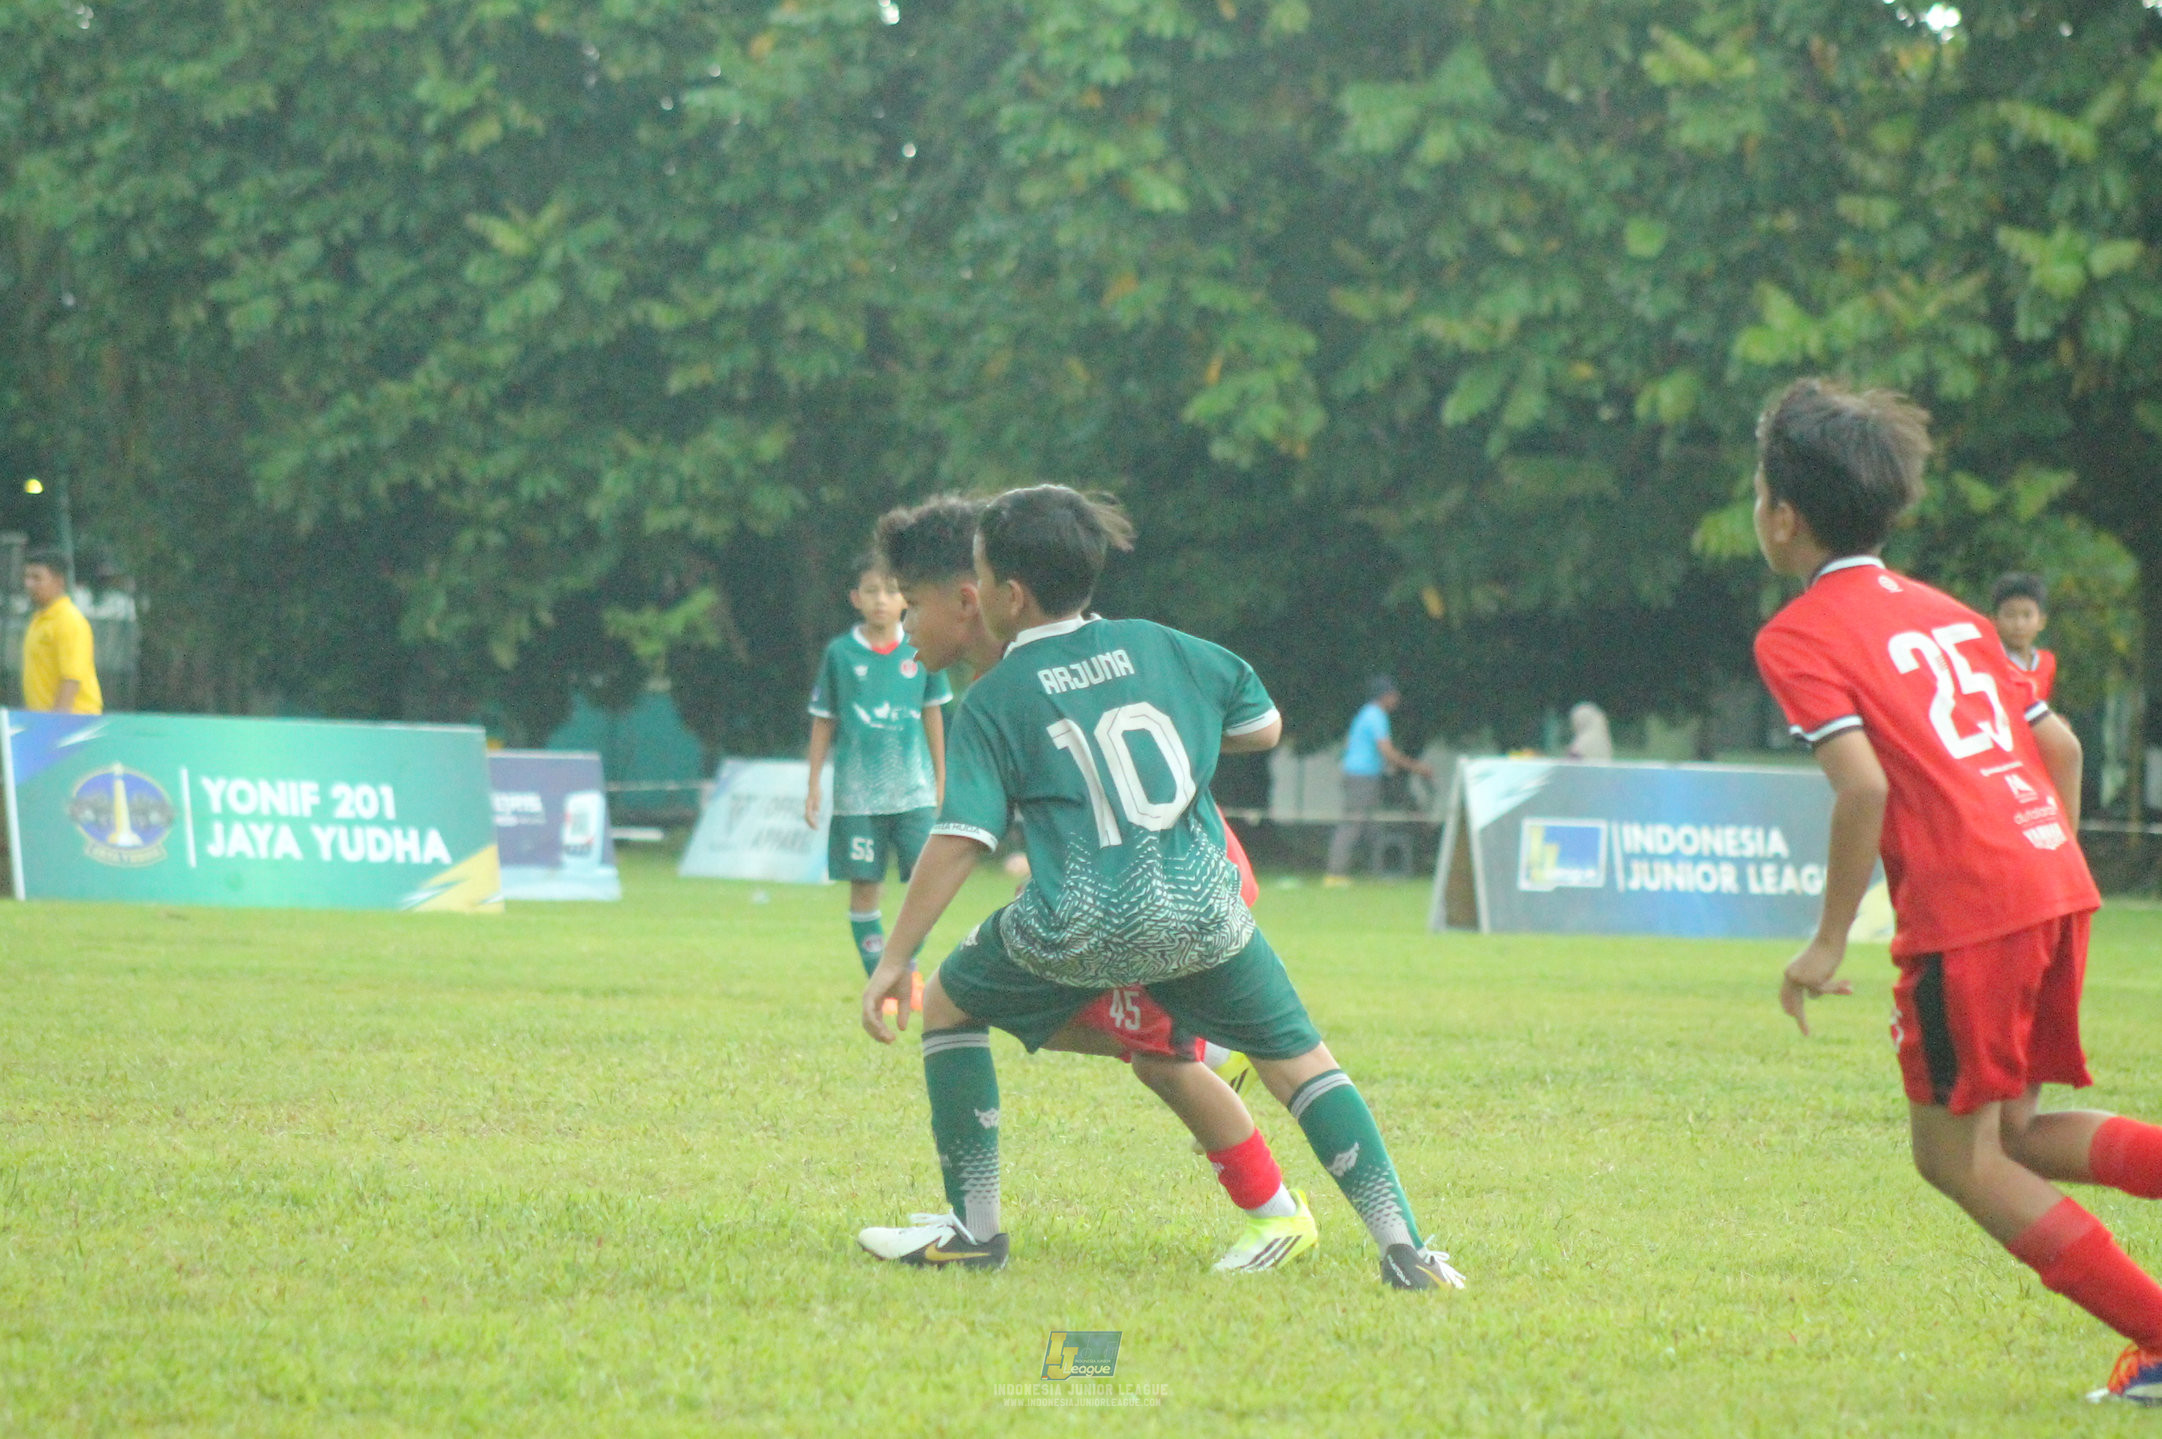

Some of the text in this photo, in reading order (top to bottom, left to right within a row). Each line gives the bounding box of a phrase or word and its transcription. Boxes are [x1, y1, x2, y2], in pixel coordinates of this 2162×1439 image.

[1037, 649, 1135, 695] ARJUNA
[1887, 622, 2013, 759] 25
[1046, 701, 1196, 848] 10
[200, 775, 396, 821] YONIF 201
[207, 820, 304, 861] JAYA
[310, 822, 453, 865] YUDHA
[1622, 822, 1790, 858] INDONESIA
[1628, 859, 1741, 894] JUNIOR
[1746, 861, 1828, 896] LEAG
[1109, 988, 1141, 1030] 45
